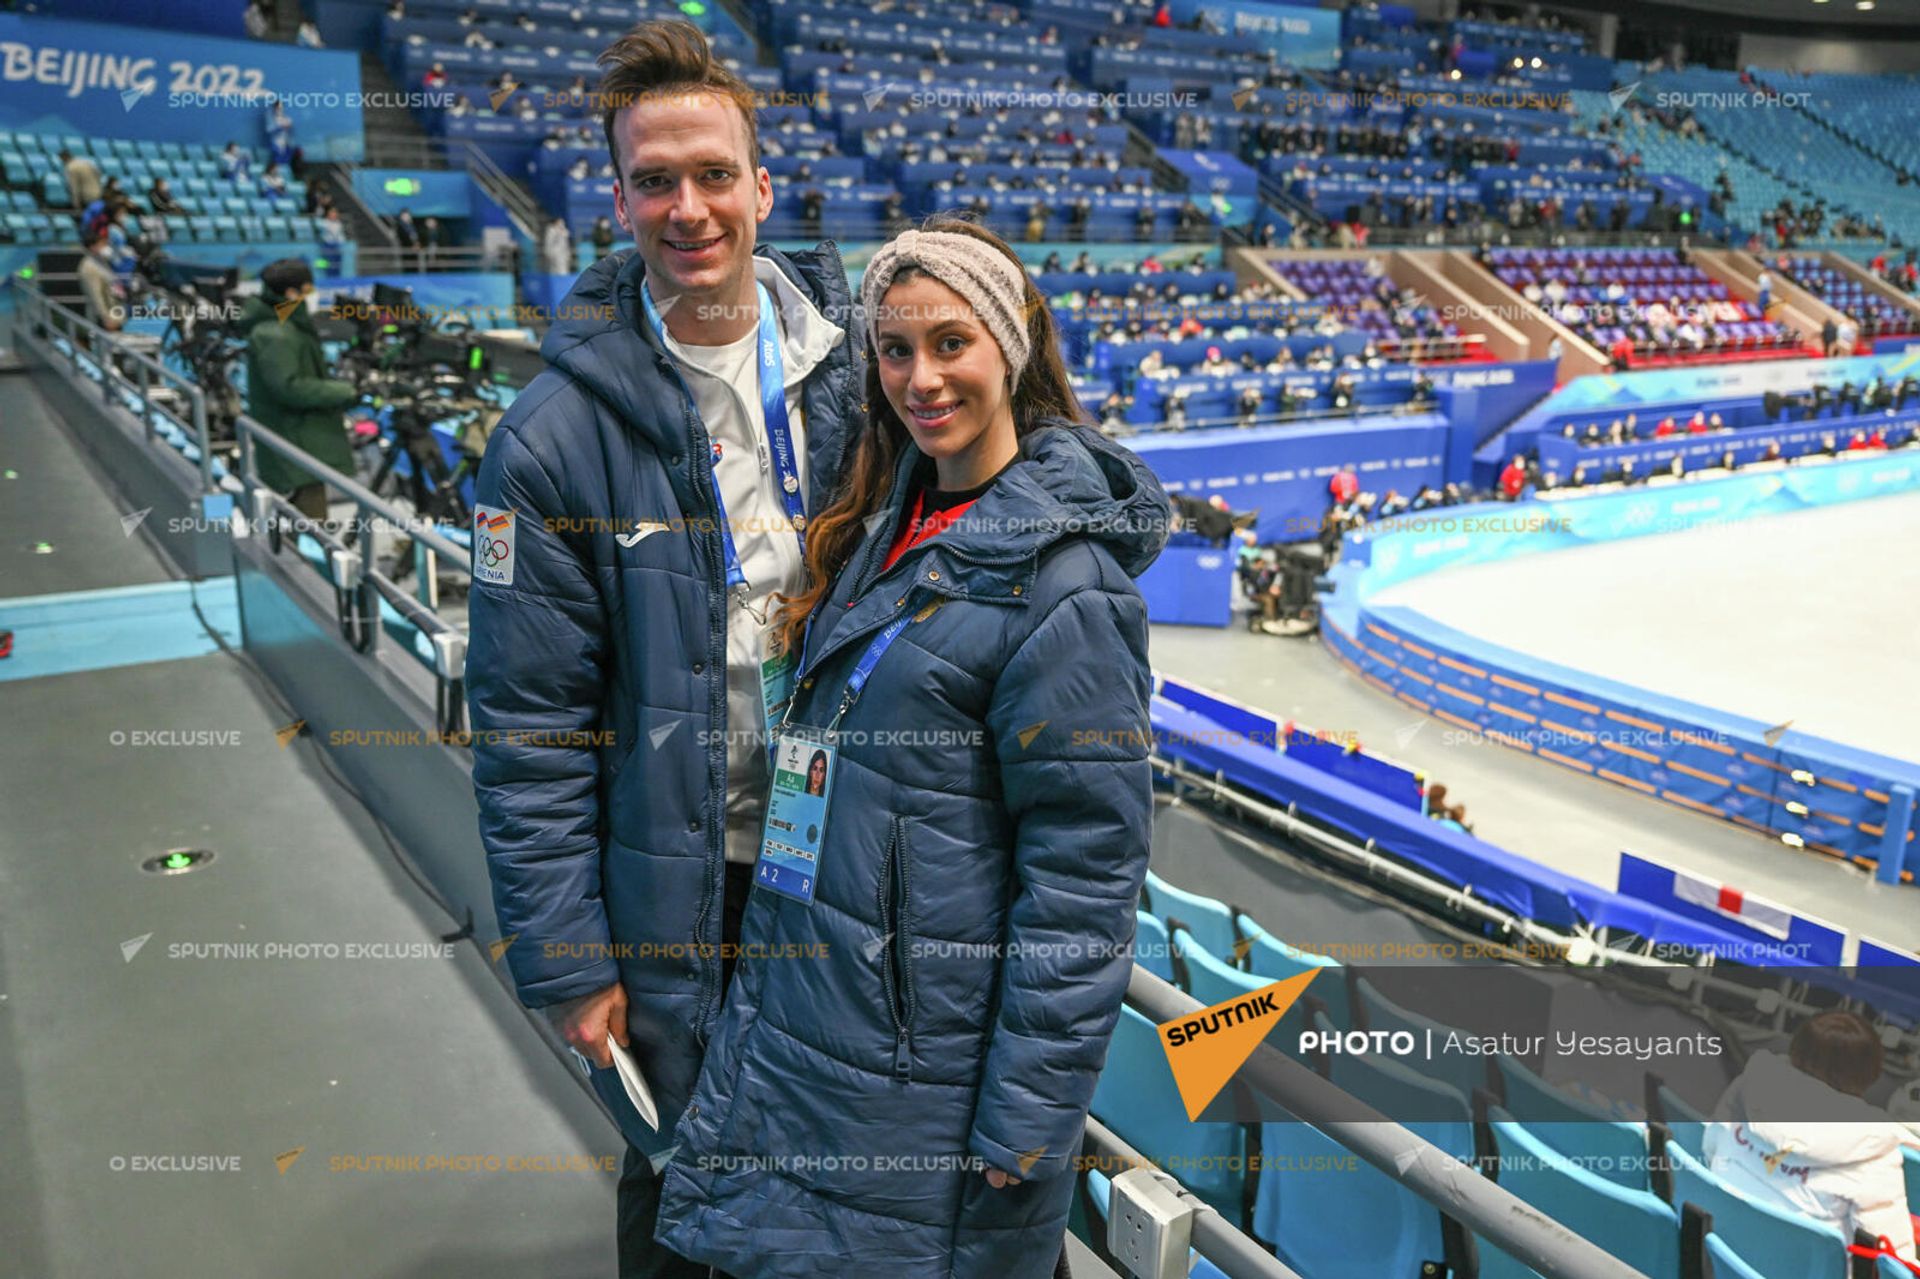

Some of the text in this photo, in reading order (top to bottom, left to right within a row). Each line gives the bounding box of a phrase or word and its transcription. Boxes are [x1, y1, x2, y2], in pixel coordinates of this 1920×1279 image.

[0, 42, 269, 98] BEIJING 2022
[774, 428, 790, 468] BEIJING
[760, 865, 810, 893] A 2 R
